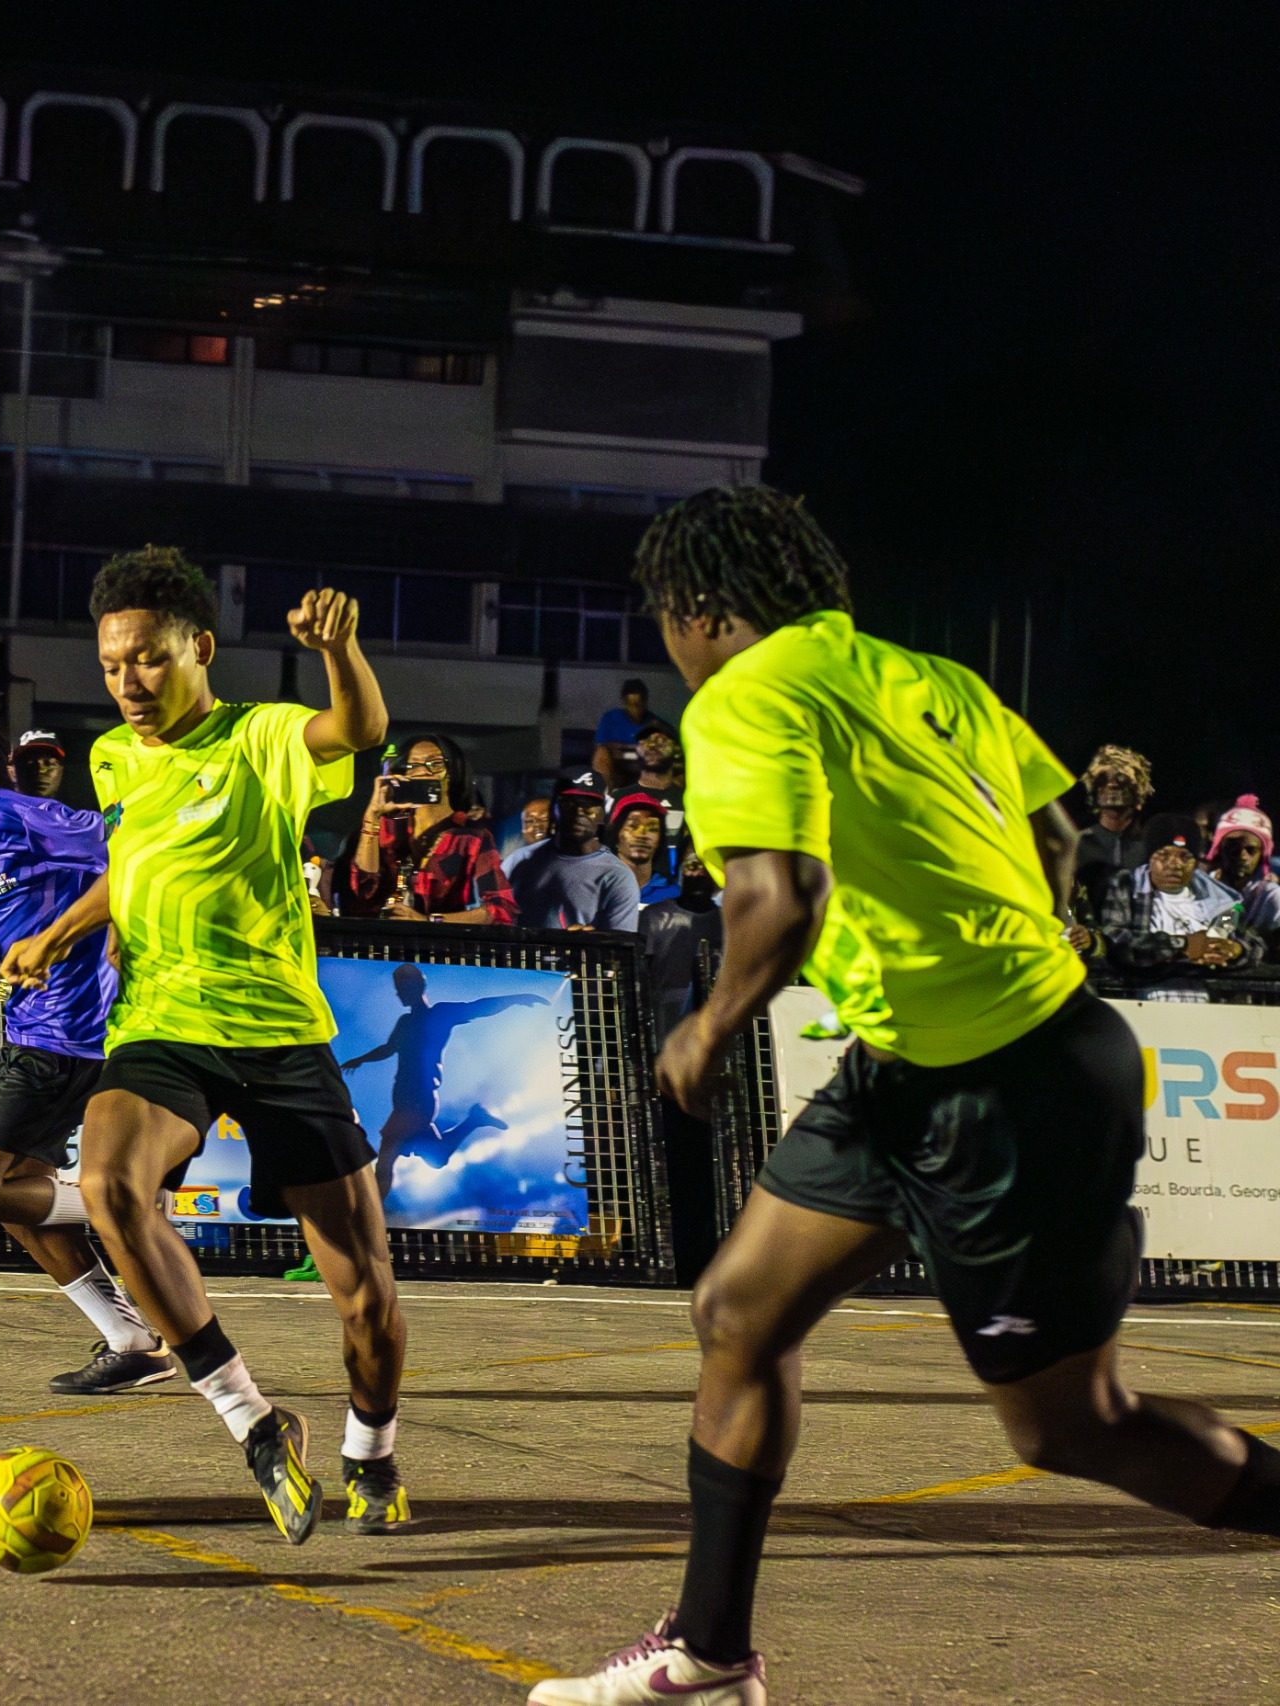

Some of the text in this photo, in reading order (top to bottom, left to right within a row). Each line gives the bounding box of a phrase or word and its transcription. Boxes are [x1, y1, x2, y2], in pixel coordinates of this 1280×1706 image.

[556, 1016, 588, 1188] GUINNESS
[1133, 1183, 1164, 1196] oad,
[1168, 1182, 1226, 1198] Bourda,
